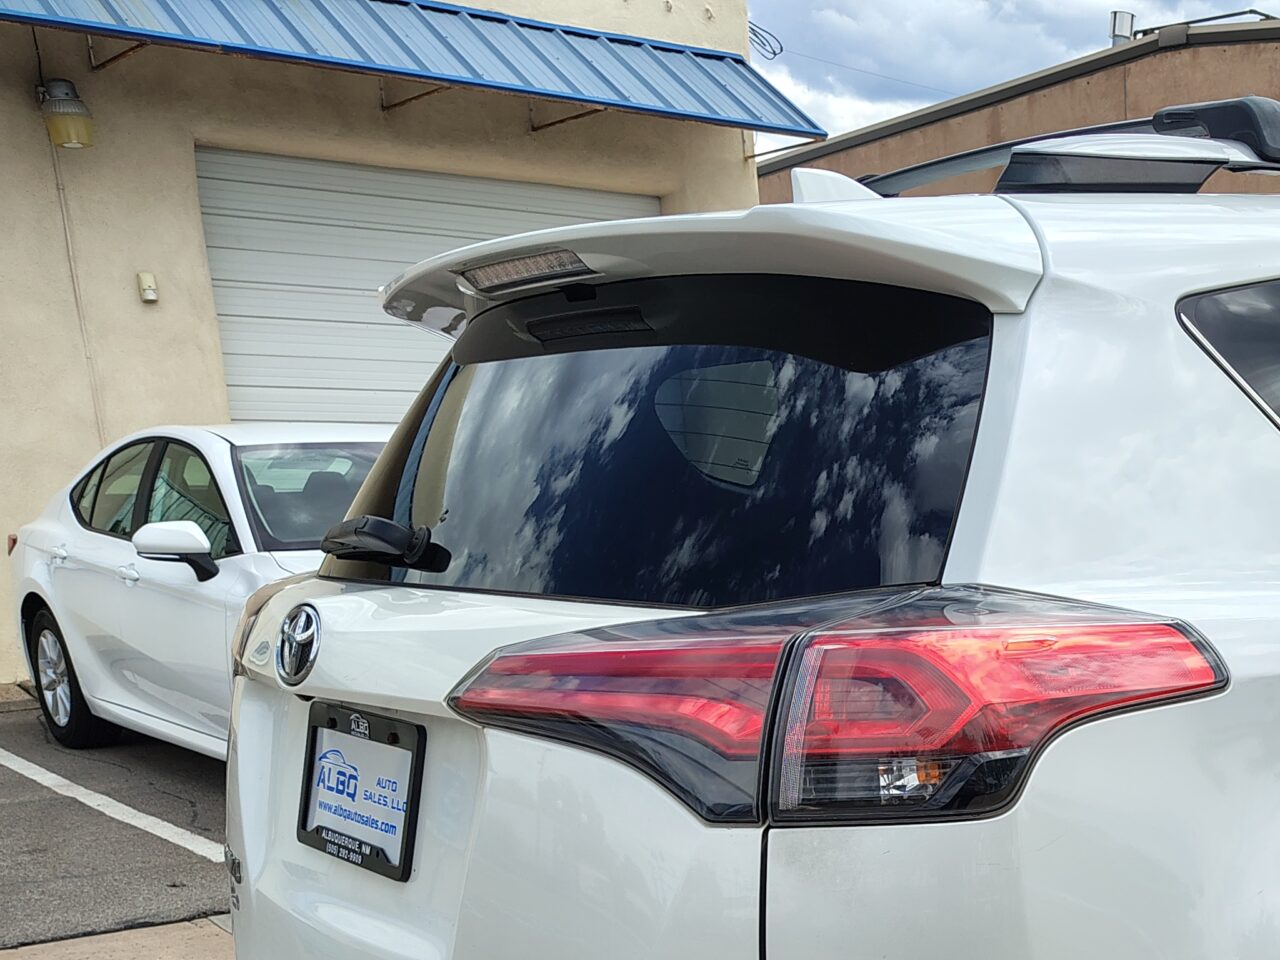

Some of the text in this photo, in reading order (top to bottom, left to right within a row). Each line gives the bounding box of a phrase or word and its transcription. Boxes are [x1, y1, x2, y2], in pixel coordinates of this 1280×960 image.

[351, 719, 369, 737] ALBQ
[317, 765, 358, 802] ALBQ
[376, 777, 397, 792] AUTO
[318, 800, 397, 836] www.albqautosales.com
[322, 828, 371, 855] ALBUQUERQUE, NM
